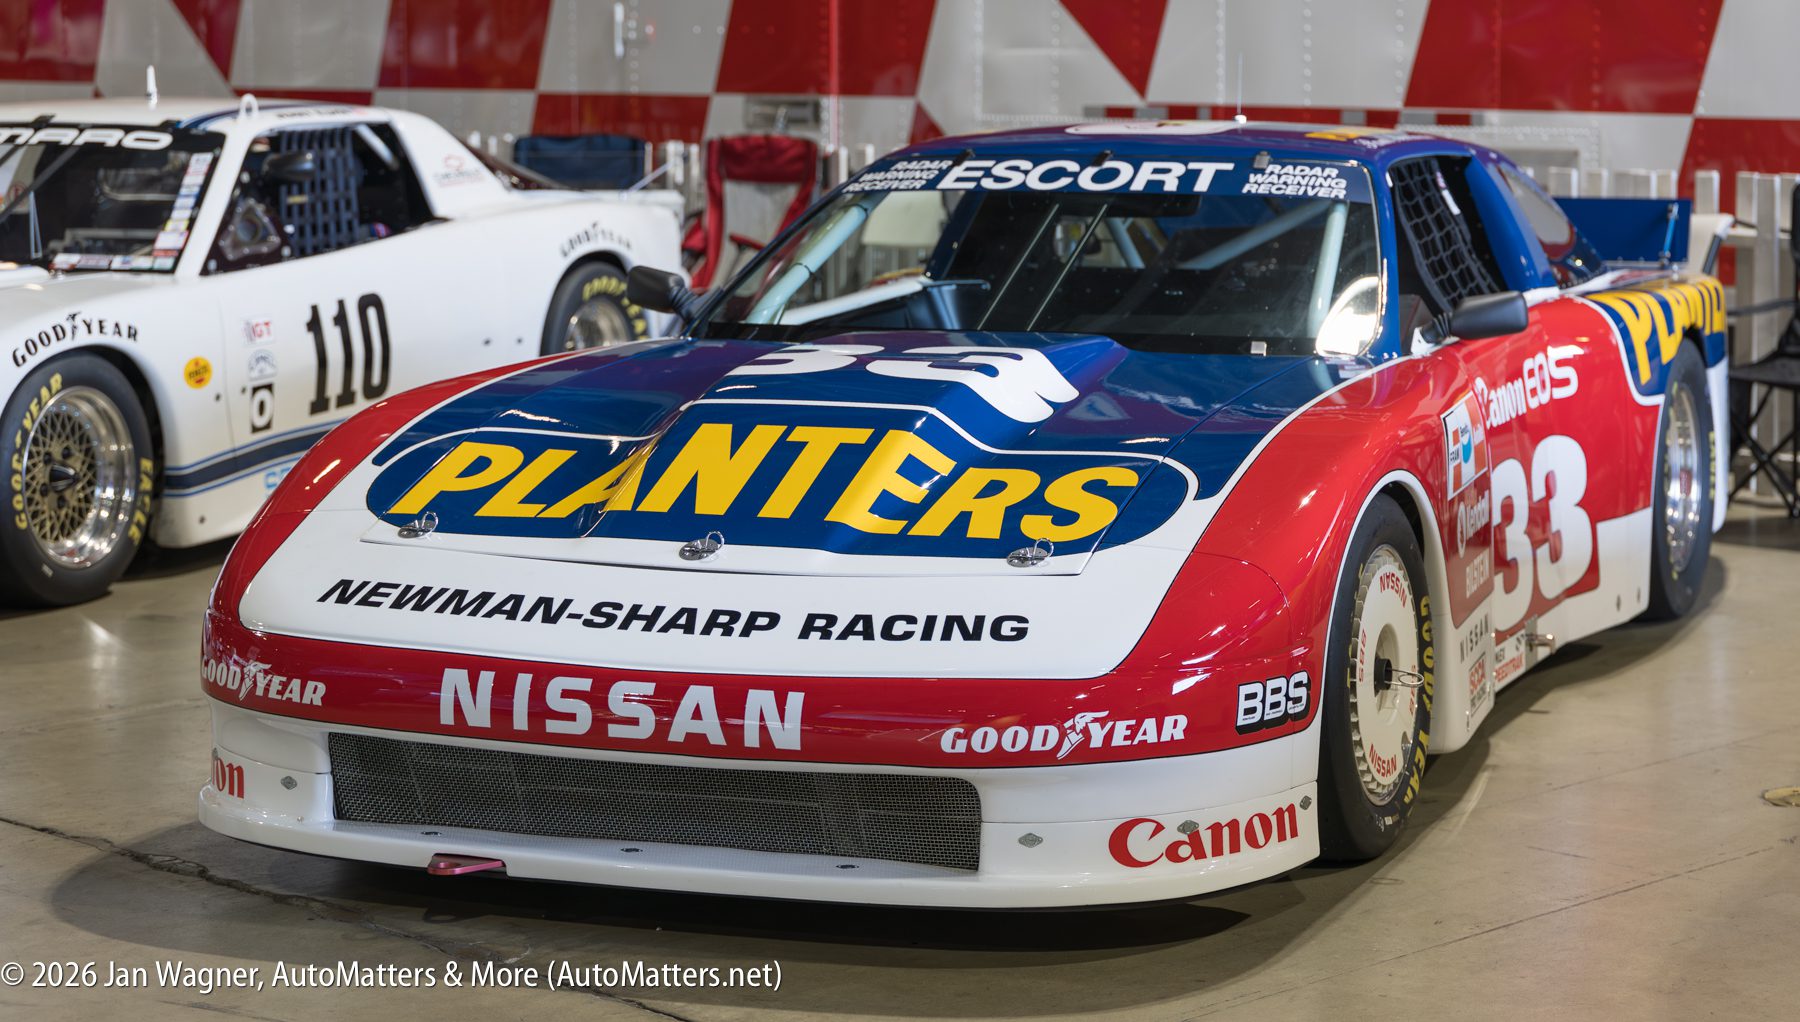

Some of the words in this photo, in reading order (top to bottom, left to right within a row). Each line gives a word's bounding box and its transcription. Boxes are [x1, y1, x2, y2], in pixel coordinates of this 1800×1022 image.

[842, 180, 928, 193] RECEIVER
[859, 170, 939, 181] WARNING
[891, 160, 954, 170] RADAR
[936, 159, 1235, 191] ESCORT
[1248, 174, 1347, 188] WARNING
[1264, 164, 1339, 179] RADAR
[1241, 183, 1347, 199] RECEIVER
[306, 293, 390, 416] 110
[722, 344, 1080, 424] 33
[389, 422, 1140, 542] PLANTERS
[1493, 434, 1593, 630] 33
[318, 578, 780, 638] NEWMAN-SHARP
[797, 613, 1030, 642] RACING
[1378, 571, 1408, 608] NISSAN
[1460, 613, 1489, 664] NISSAN
[439, 667, 805, 752] NISSAN
[1236, 670, 1311, 732] BBS
[1368, 743, 1397, 778] NISSAN
[1108, 802, 1299, 868] Canon
